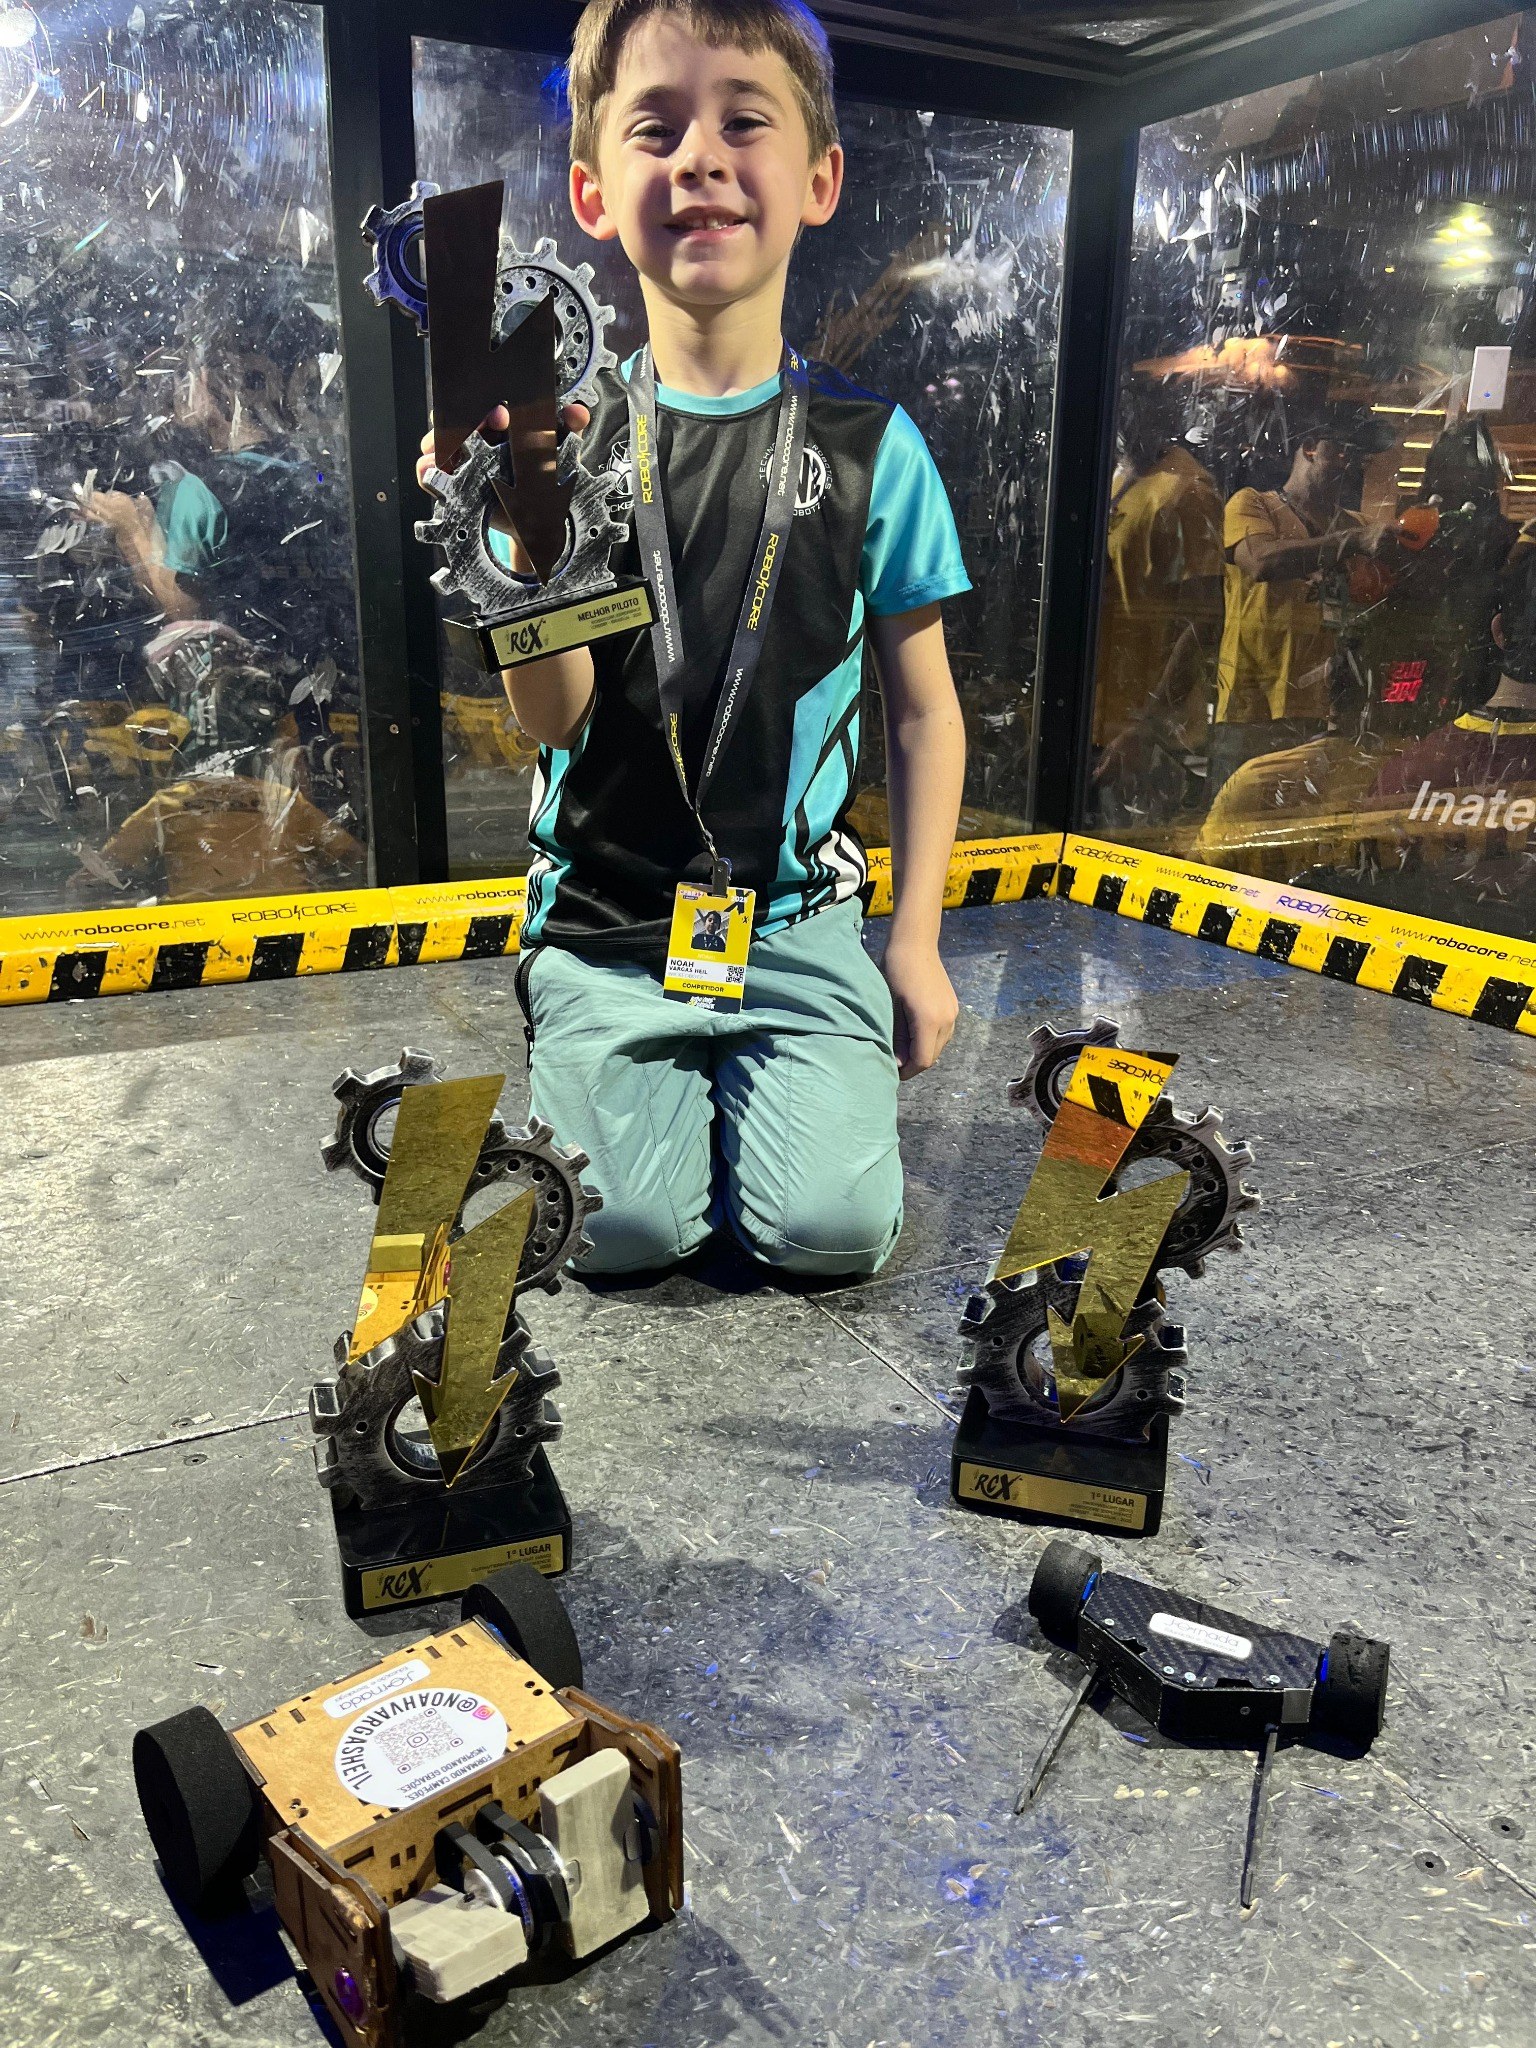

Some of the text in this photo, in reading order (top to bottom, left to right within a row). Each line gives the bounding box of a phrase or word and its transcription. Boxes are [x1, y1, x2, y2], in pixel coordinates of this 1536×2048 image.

[777, 395, 798, 497] www.robocore.net
[811, 444, 833, 490] ROBOTICS
[577, 606, 611, 622] MELHOR
[611, 597, 640, 613] PILOTO
[652, 550, 676, 663] www.robocore.net
[508, 617, 547, 655] RCX
[705, 667, 744, 778] www.robocore.net
[1408, 780, 1536, 832] Inate
[1156, 866, 1261, 899] www.robocore.net
[19, 917, 206, 940] www.robocore.net
[668, 965, 693, 974] VARGAS
[670, 958, 695, 968] NOAH
[681, 982, 725, 993] COMPETIDOR
[974, 1473, 1023, 1501] RCX
[1102, 1493, 1135, 1508] LUGAR
[518, 1542, 552, 1557] LUGAR
[380, 1561, 432, 1600] RCX
[339, 1670, 415, 1711] Jornada
[340, 1691, 479, 1791] @NOAHVARGASHEIL
[442, 1745, 487, 1774] INSPIRANDO
[449, 1754, 493, 1780] FORMANDO
